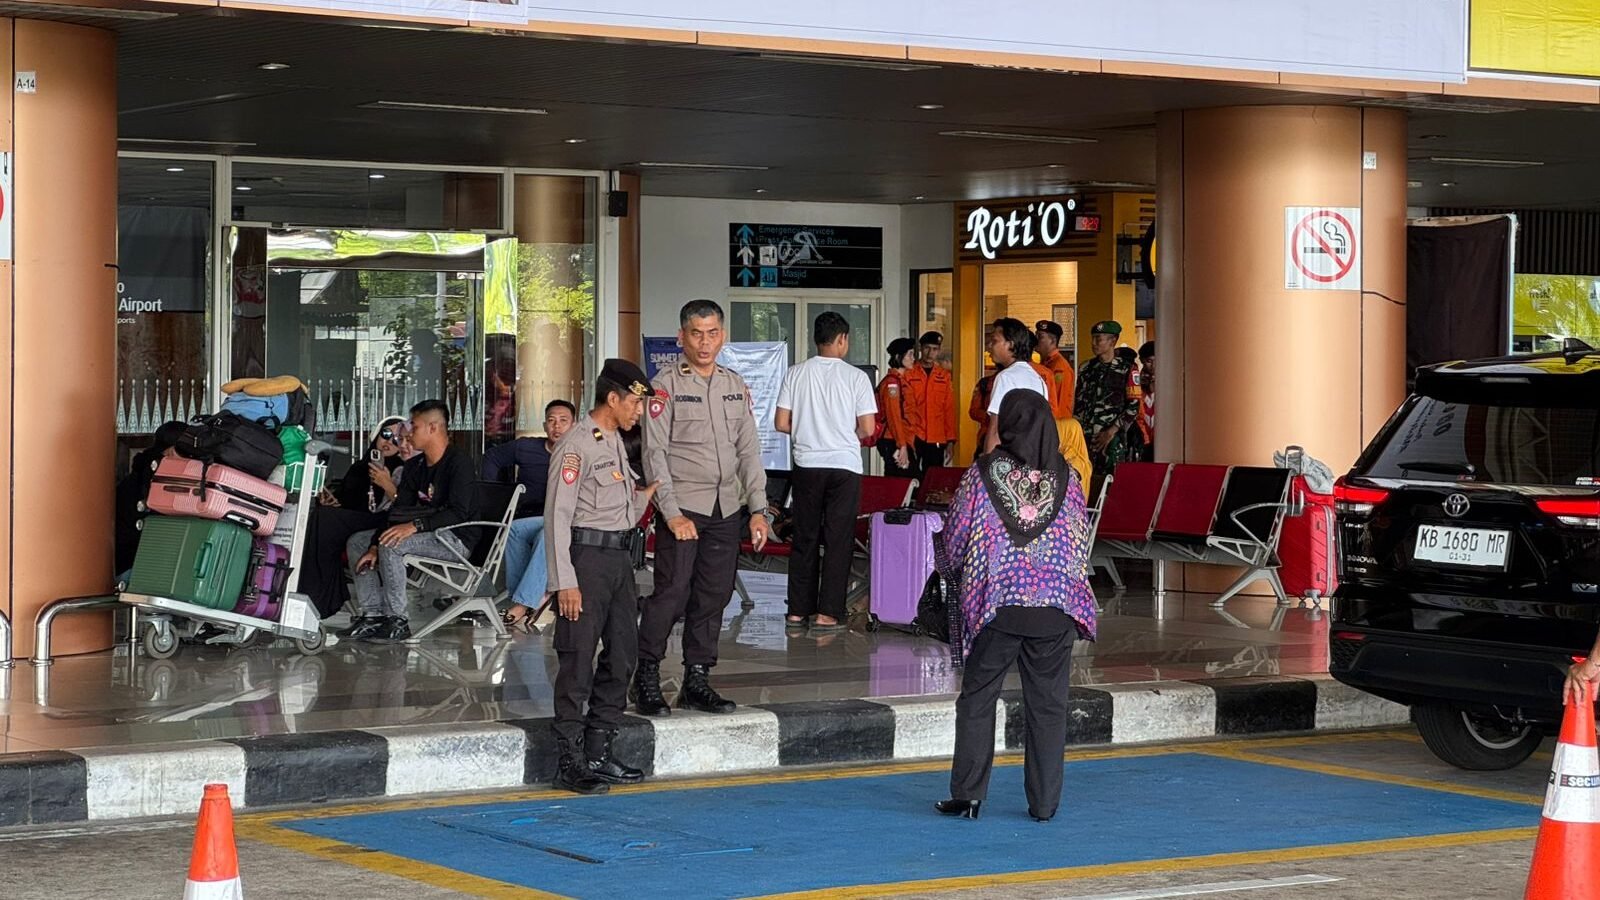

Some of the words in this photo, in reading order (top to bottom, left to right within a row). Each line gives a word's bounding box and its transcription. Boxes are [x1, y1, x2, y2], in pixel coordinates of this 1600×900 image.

[16, 78, 35, 89] A-14
[758, 225, 800, 236] Emergency
[802, 227, 835, 236] Services
[827, 237, 849, 246] Room
[782, 269, 807, 280] Masjid
[118, 297, 162, 315] Airport
[1419, 528, 1439, 548] KB
[1442, 530, 1480, 552] 1680
[1486, 534, 1506, 554] MR
[1567, 775, 1600, 787] secu
